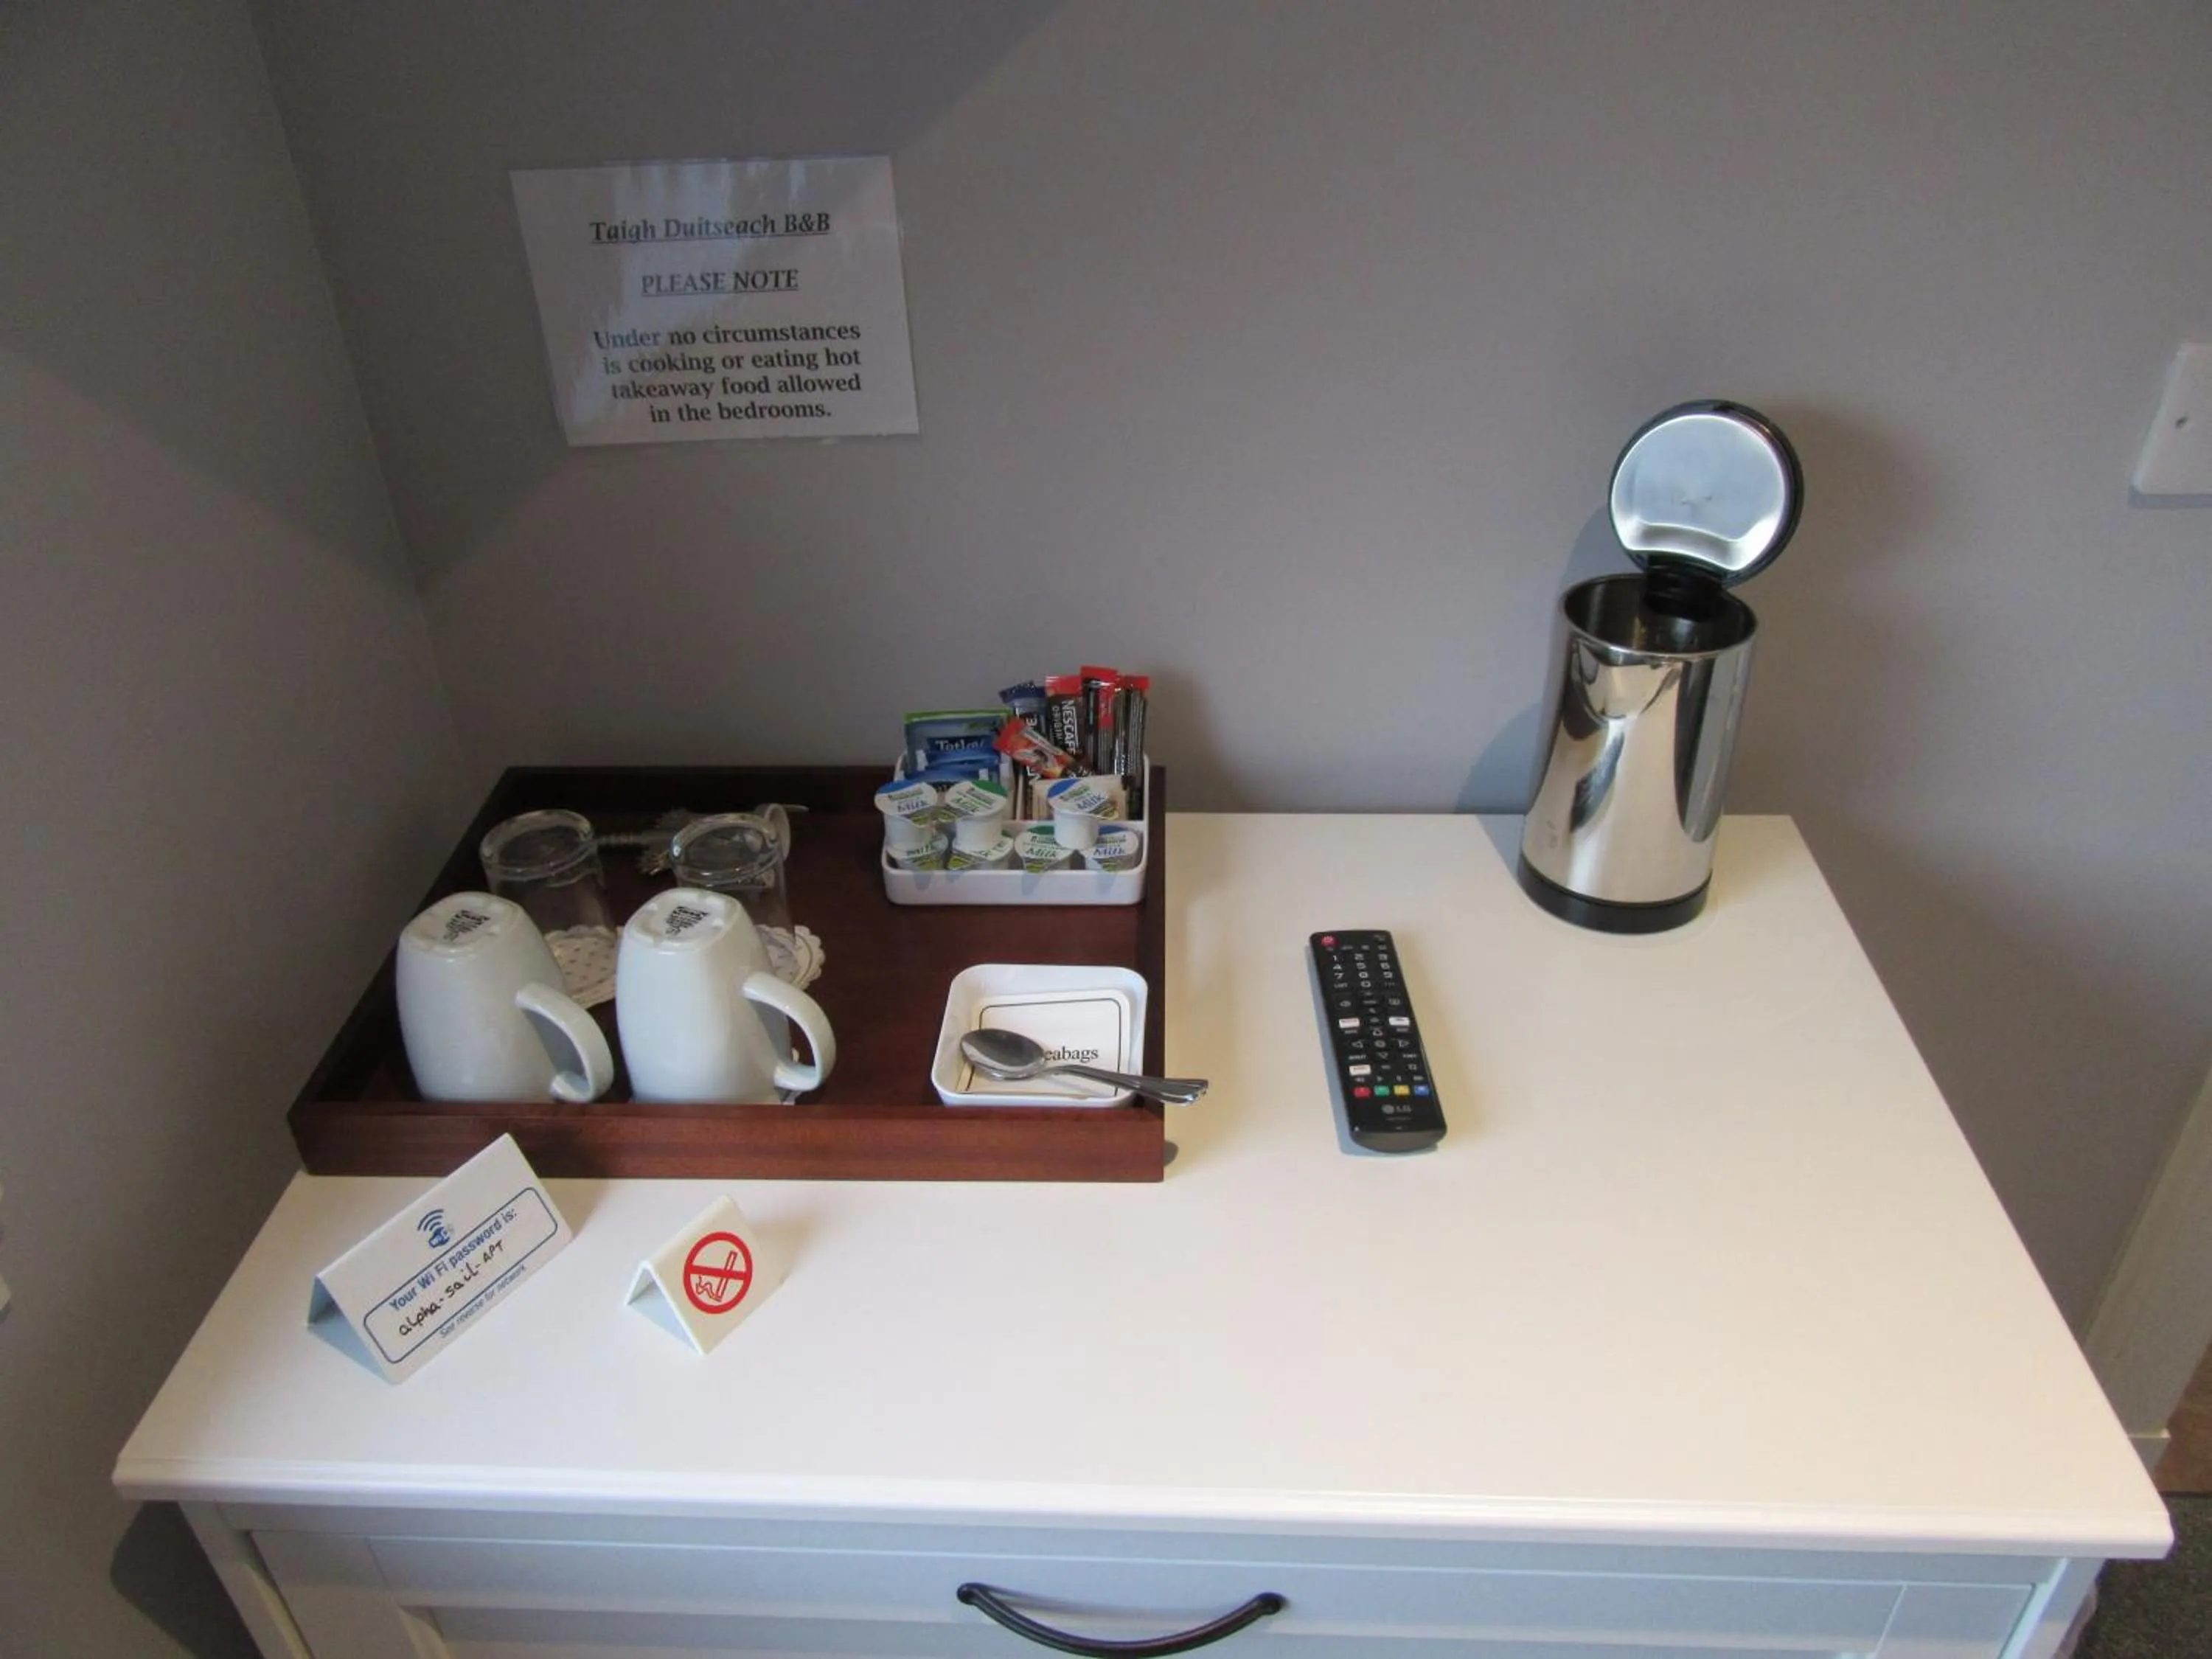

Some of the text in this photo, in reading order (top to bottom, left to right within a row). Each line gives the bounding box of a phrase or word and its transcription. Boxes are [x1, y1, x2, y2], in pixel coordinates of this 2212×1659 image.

[589, 212, 830, 244] Taigh Duitseach B&B
[641, 268, 799, 294] PLEASE NOTE
[594, 324, 860, 349] Under no circumstances
[602, 347, 861, 375] is cooking or eating hot
[611, 372, 862, 400] takeaway food allowed
[650, 401, 832, 423] in the bedrooms.
[1043, 1046, 1099, 1062] eabags
[389, 1286, 418, 1312] Your
[417, 1273, 437, 1290] Wi
[434, 1261, 450, 1277] Fi
[449, 1218, 503, 1267] password
[500, 1208, 518, 1224] is:
